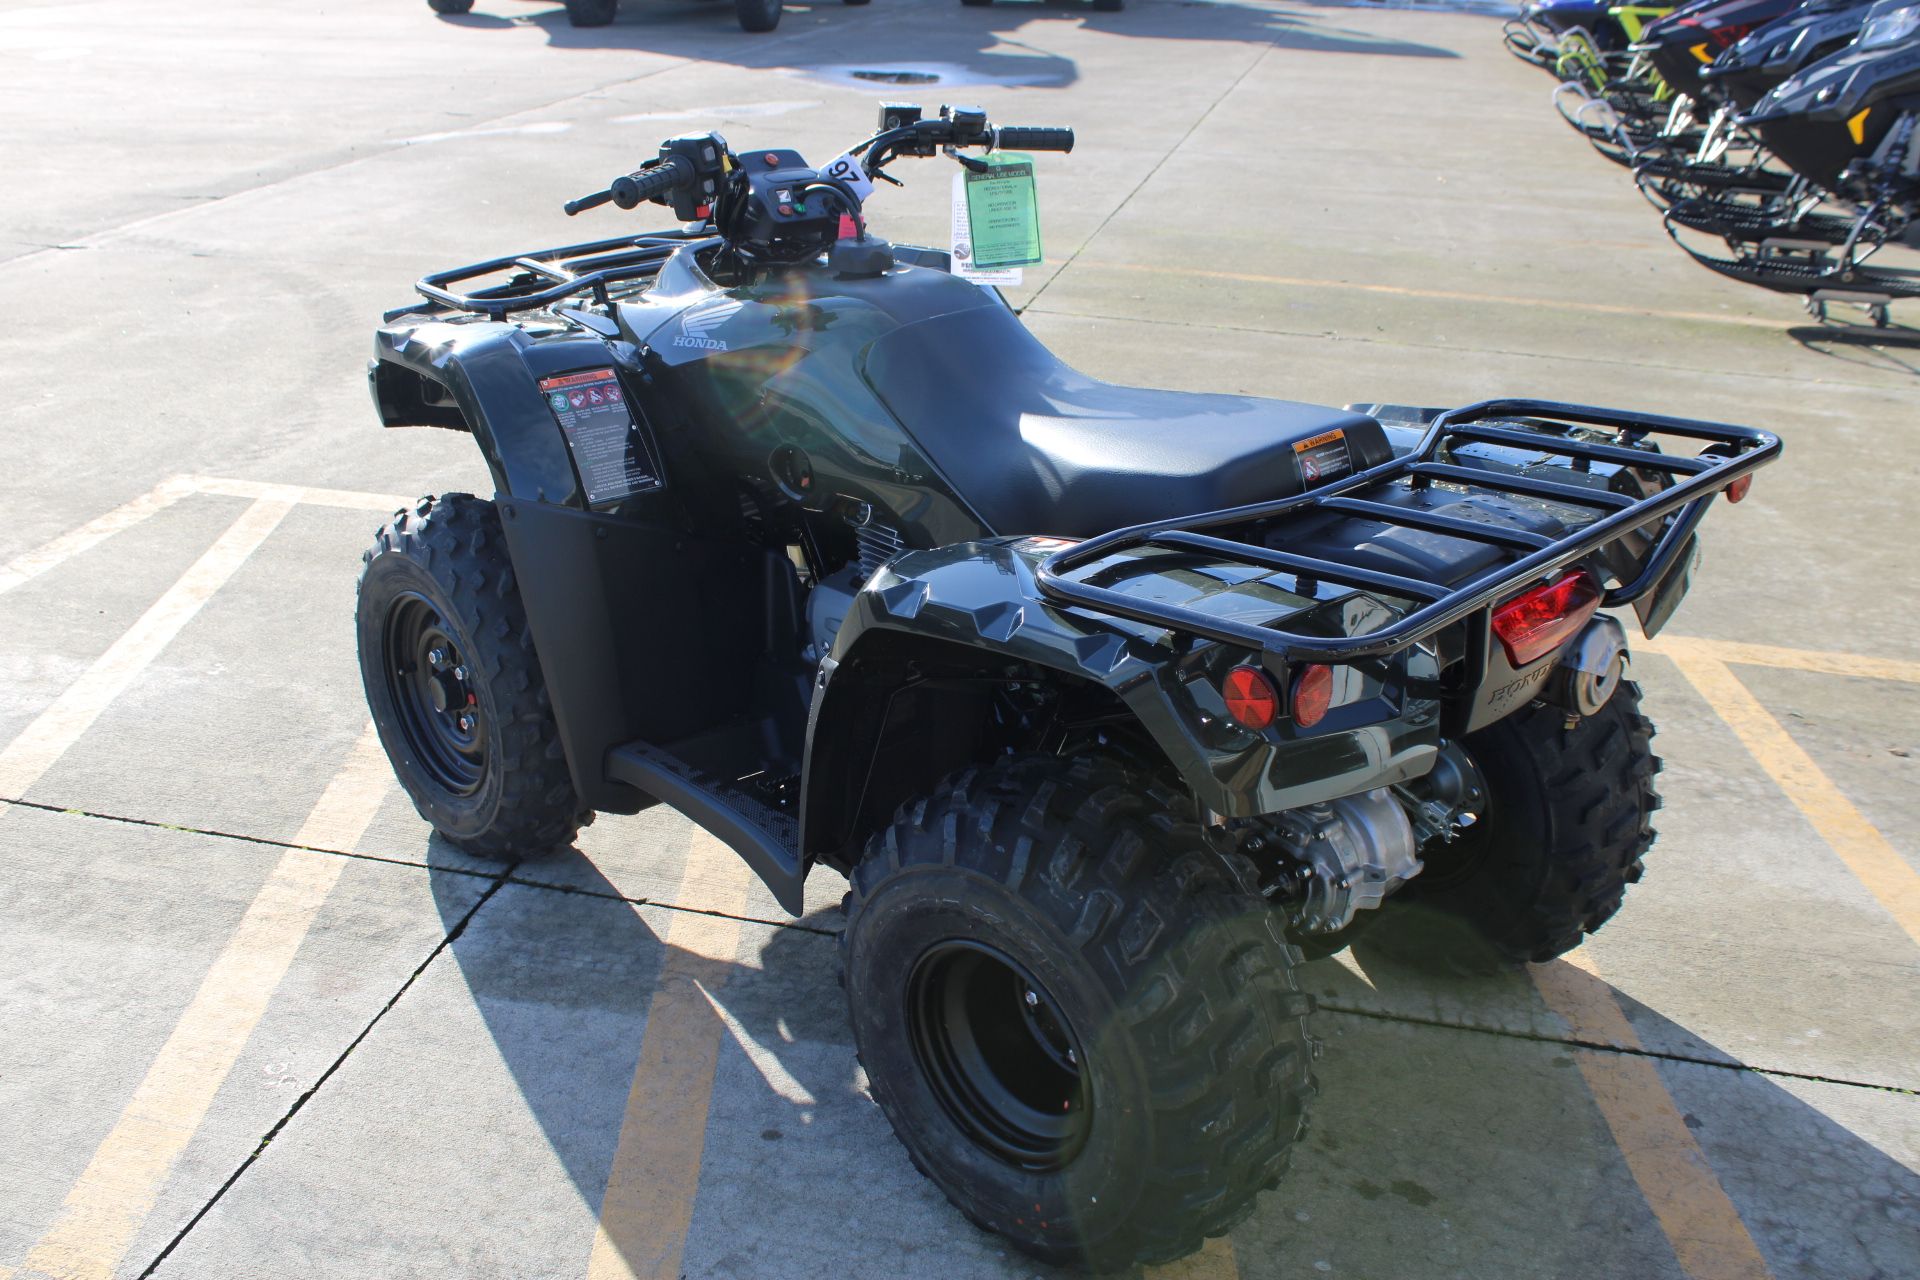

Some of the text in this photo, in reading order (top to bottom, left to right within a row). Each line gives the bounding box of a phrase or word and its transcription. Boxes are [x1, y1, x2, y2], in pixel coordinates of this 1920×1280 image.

[829, 161, 860, 181] 97
[672, 336, 728, 351] HONDA
[1308, 432, 1337, 447] WARNING
